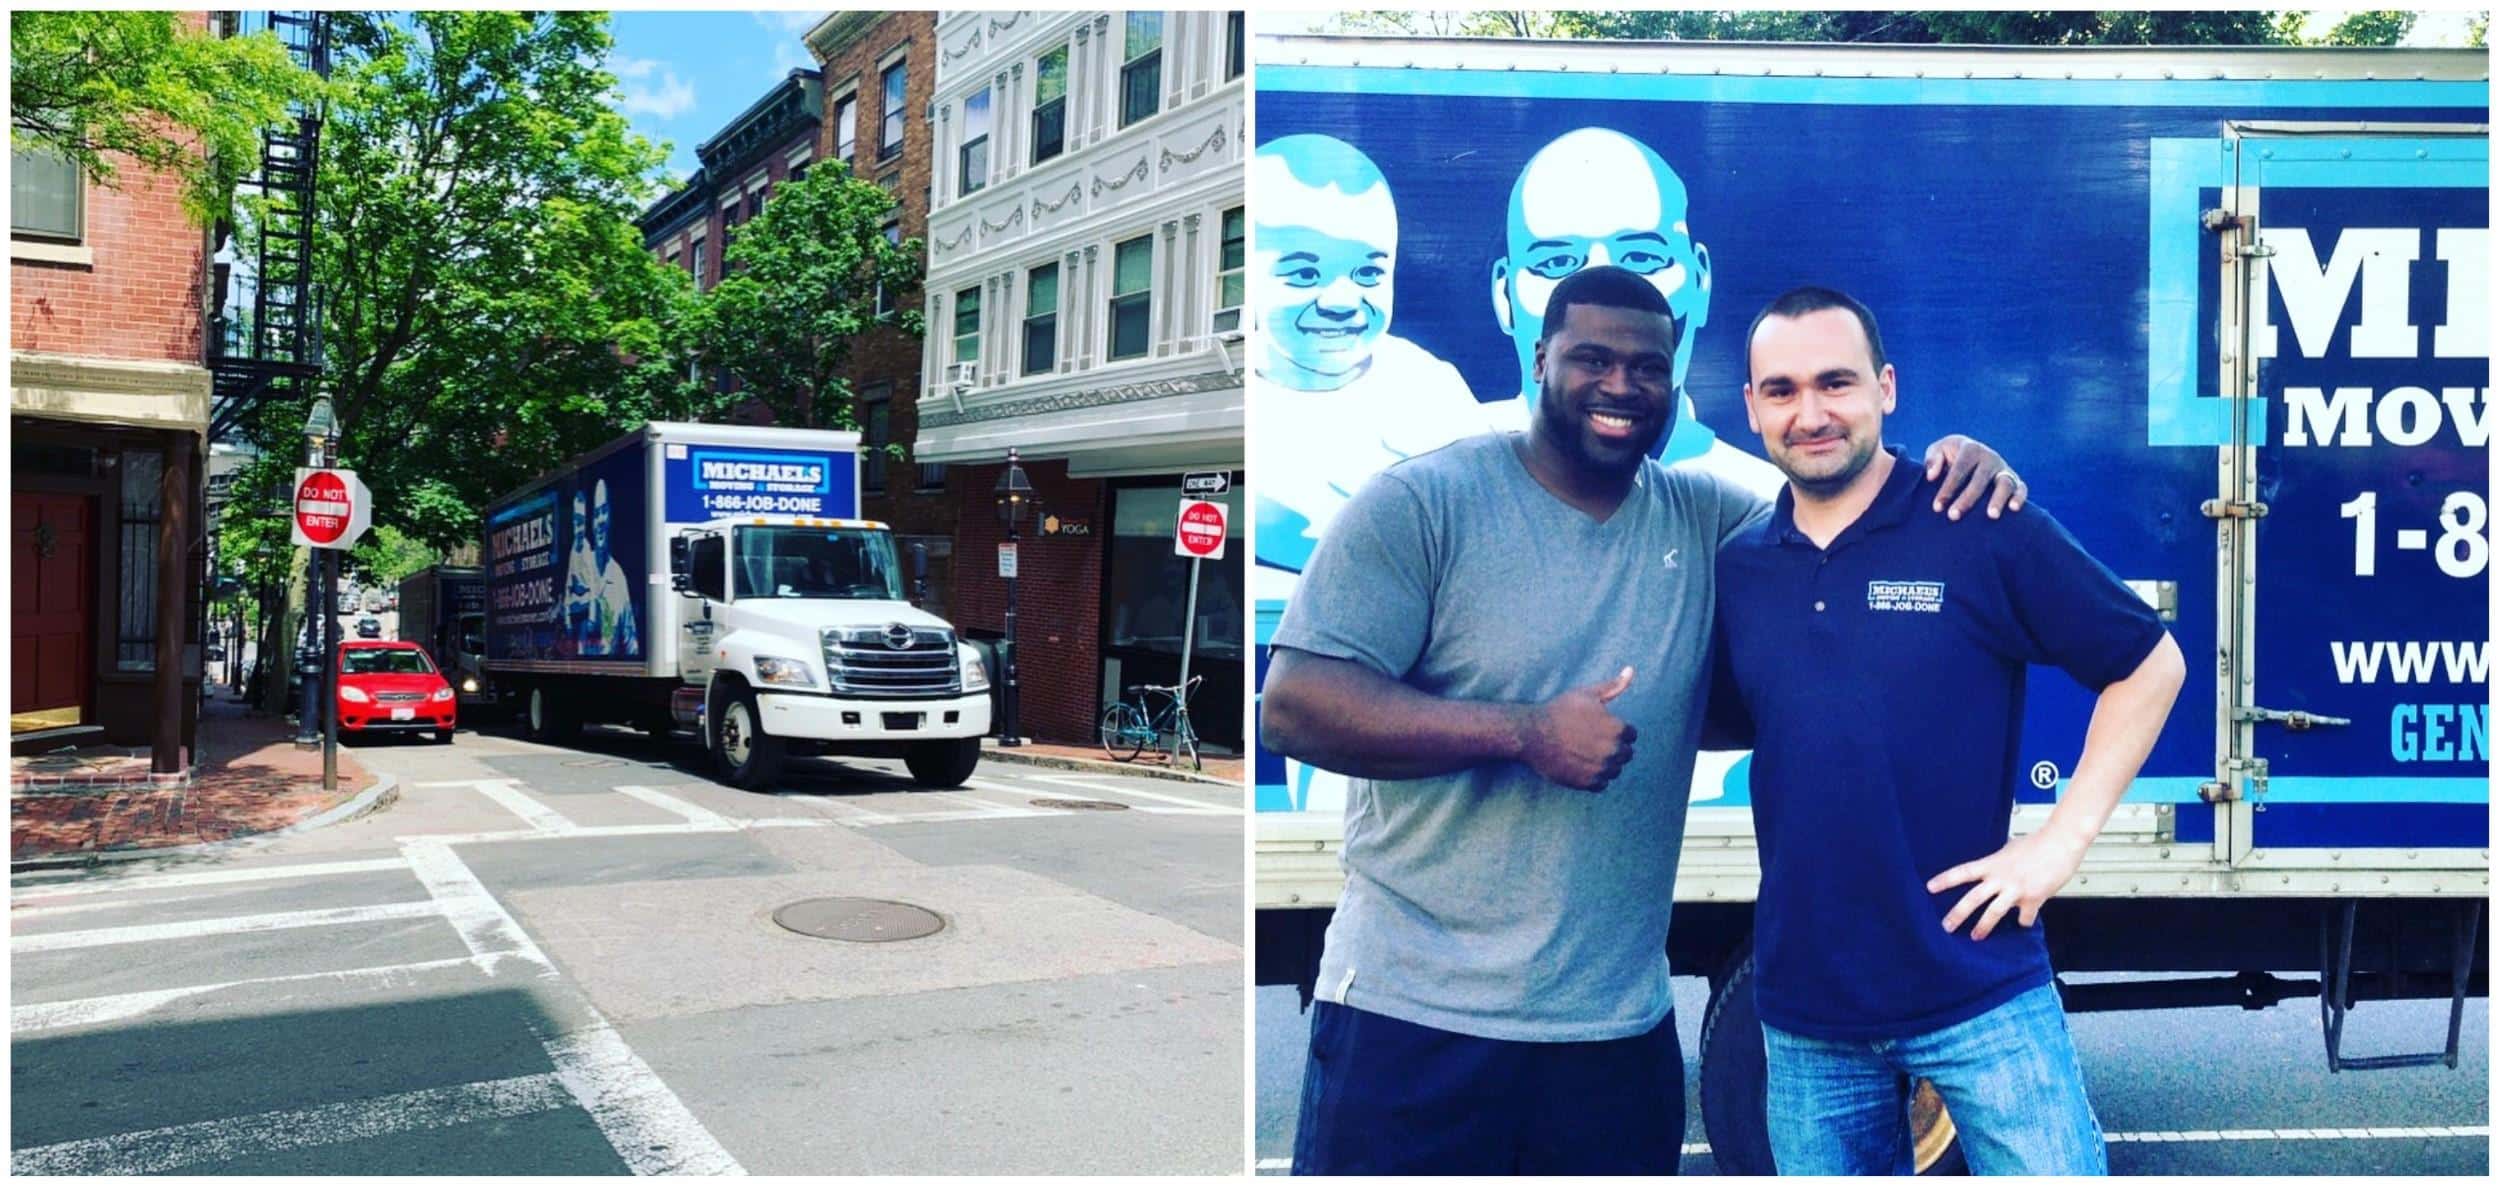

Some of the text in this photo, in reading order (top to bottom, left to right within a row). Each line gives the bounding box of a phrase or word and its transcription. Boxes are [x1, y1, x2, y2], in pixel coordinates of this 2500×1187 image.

[2222, 228, 2489, 357] MI
[2283, 387, 2489, 446] MOV
[702, 461, 821, 484] MICHAELS
[304, 487, 345, 500] DO NOT
[702, 495, 822, 512] 1-866-JOB-DONE
[306, 515, 339, 528] ENTER
[1188, 512, 1218, 523] DO NOT
[1062, 524, 1089, 535] YOGA
[2340, 491, 2489, 578] 1-8
[1188, 536, 1213, 545] ENTER
[2330, 642, 2489, 683] www
[2391, 704, 2489, 762] GEN
